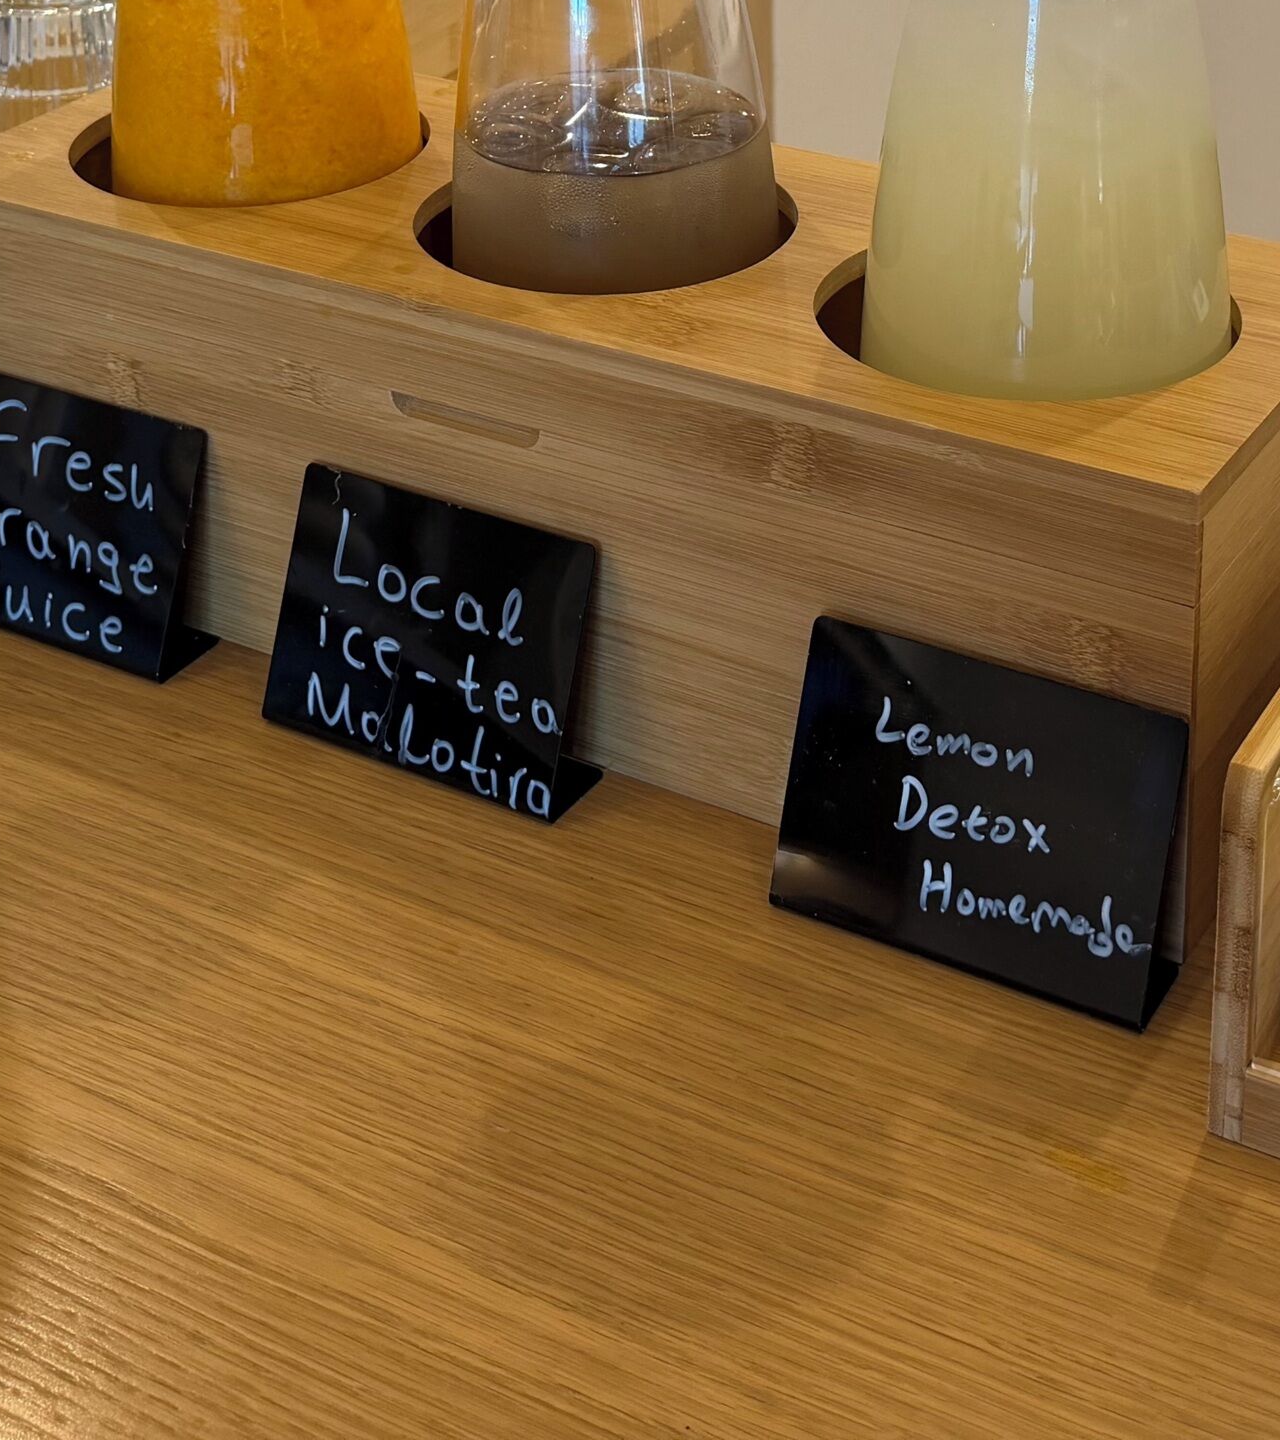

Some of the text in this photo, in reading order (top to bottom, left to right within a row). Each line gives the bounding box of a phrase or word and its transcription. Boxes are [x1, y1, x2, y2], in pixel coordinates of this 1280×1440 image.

[333, 508, 523, 646] Local
[319, 605, 562, 736] ice-tea
[307, 672, 551, 819] Malotira
[875, 696, 1034, 777] Lemon
[893, 775, 1050, 853] Detox
[920, 859, 1152, 958] Homemade
